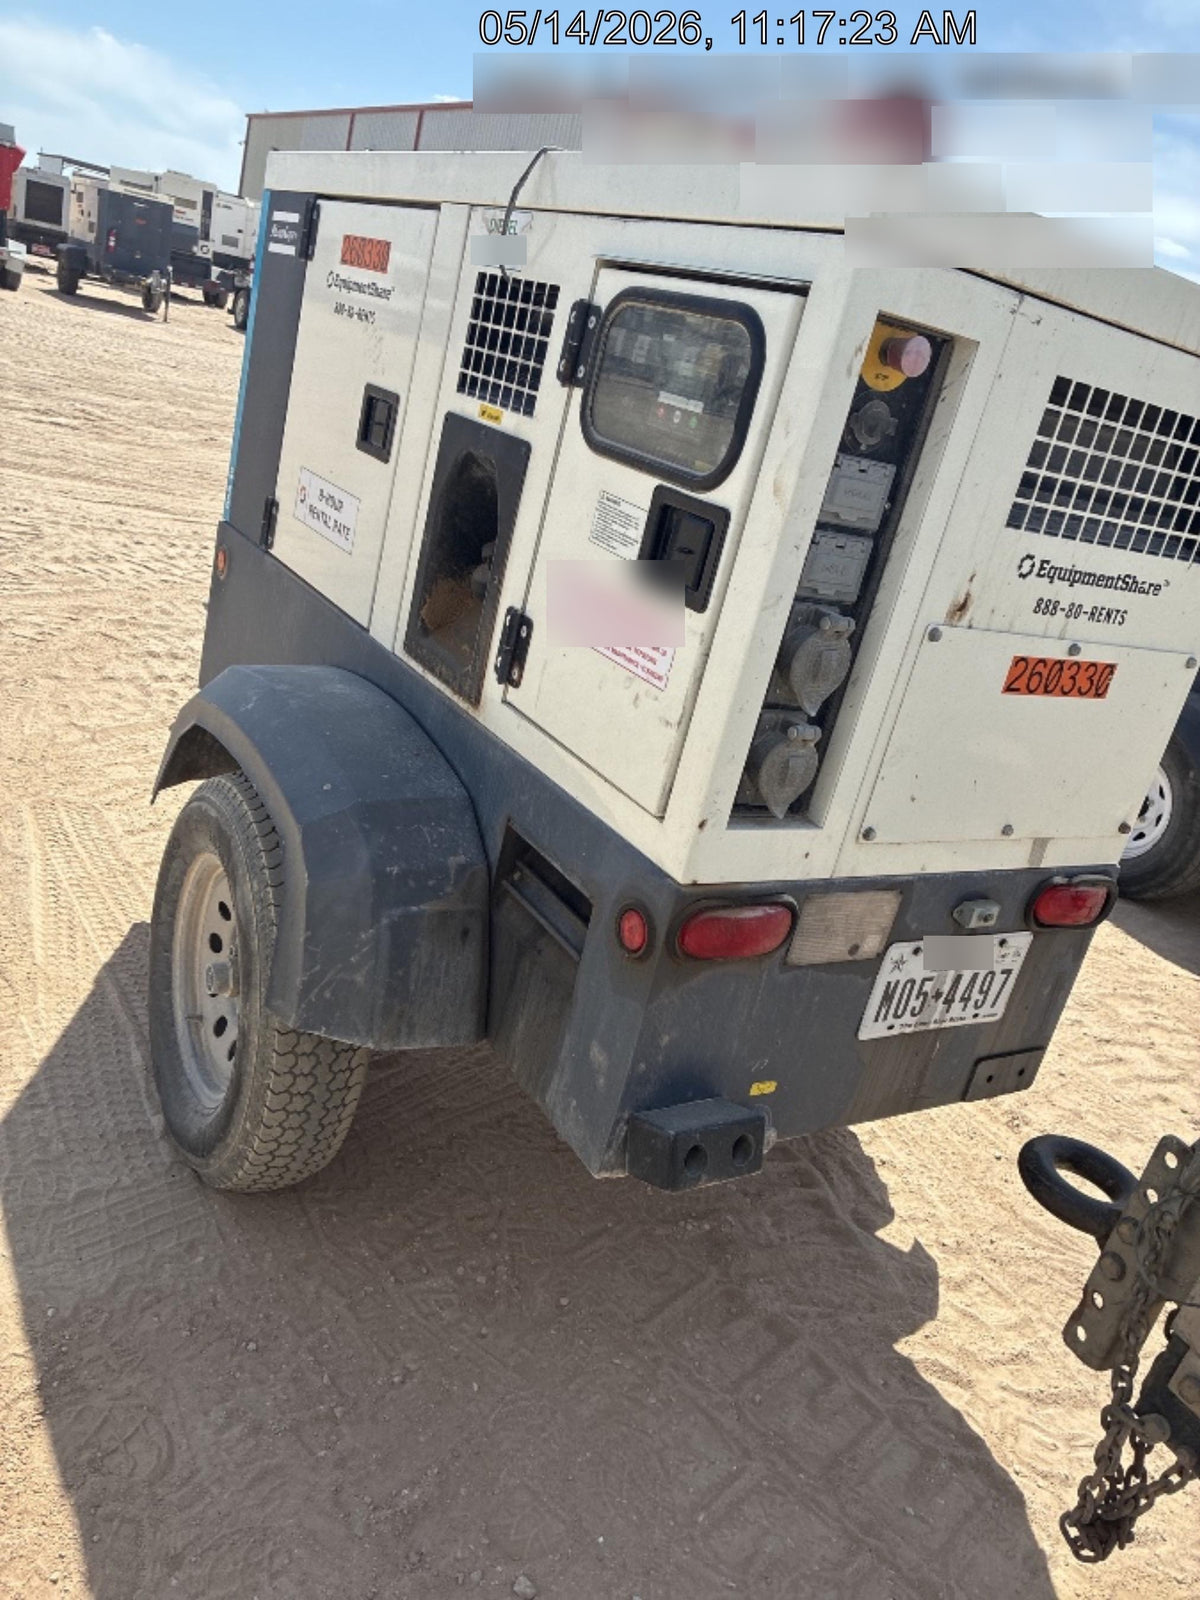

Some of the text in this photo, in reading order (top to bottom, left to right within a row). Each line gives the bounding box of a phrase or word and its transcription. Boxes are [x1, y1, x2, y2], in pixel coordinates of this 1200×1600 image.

[1035, 559, 1162, 597] EquipmentShare
[1032, 597, 1128, 626] 888-80-RENTS
[1003, 656, 1118, 698] 260330
